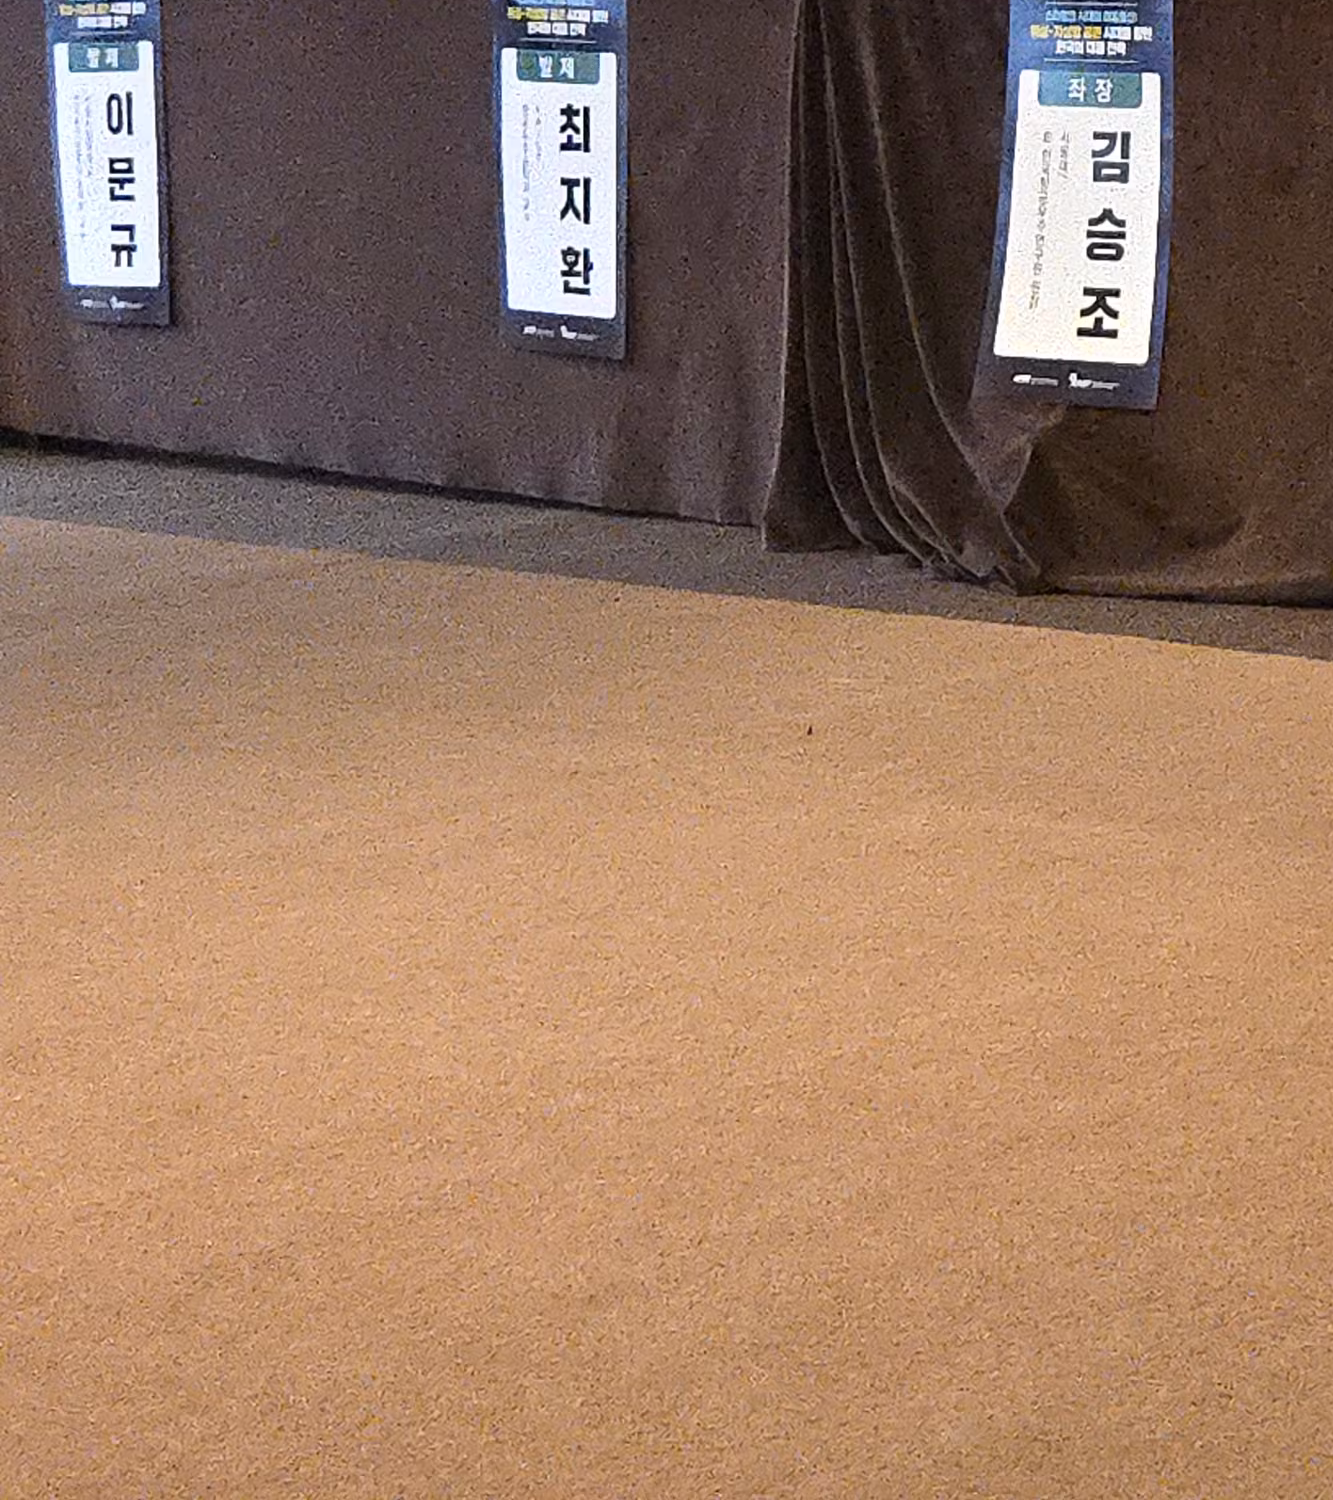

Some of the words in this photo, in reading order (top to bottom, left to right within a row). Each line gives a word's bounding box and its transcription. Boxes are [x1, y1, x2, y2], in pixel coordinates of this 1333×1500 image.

[105, 90, 138, 268] 이문규
[1067, 76, 1114, 103] 좌장
[558, 102, 595, 297] 최지환
[1075, 129, 1133, 341] 김승조
